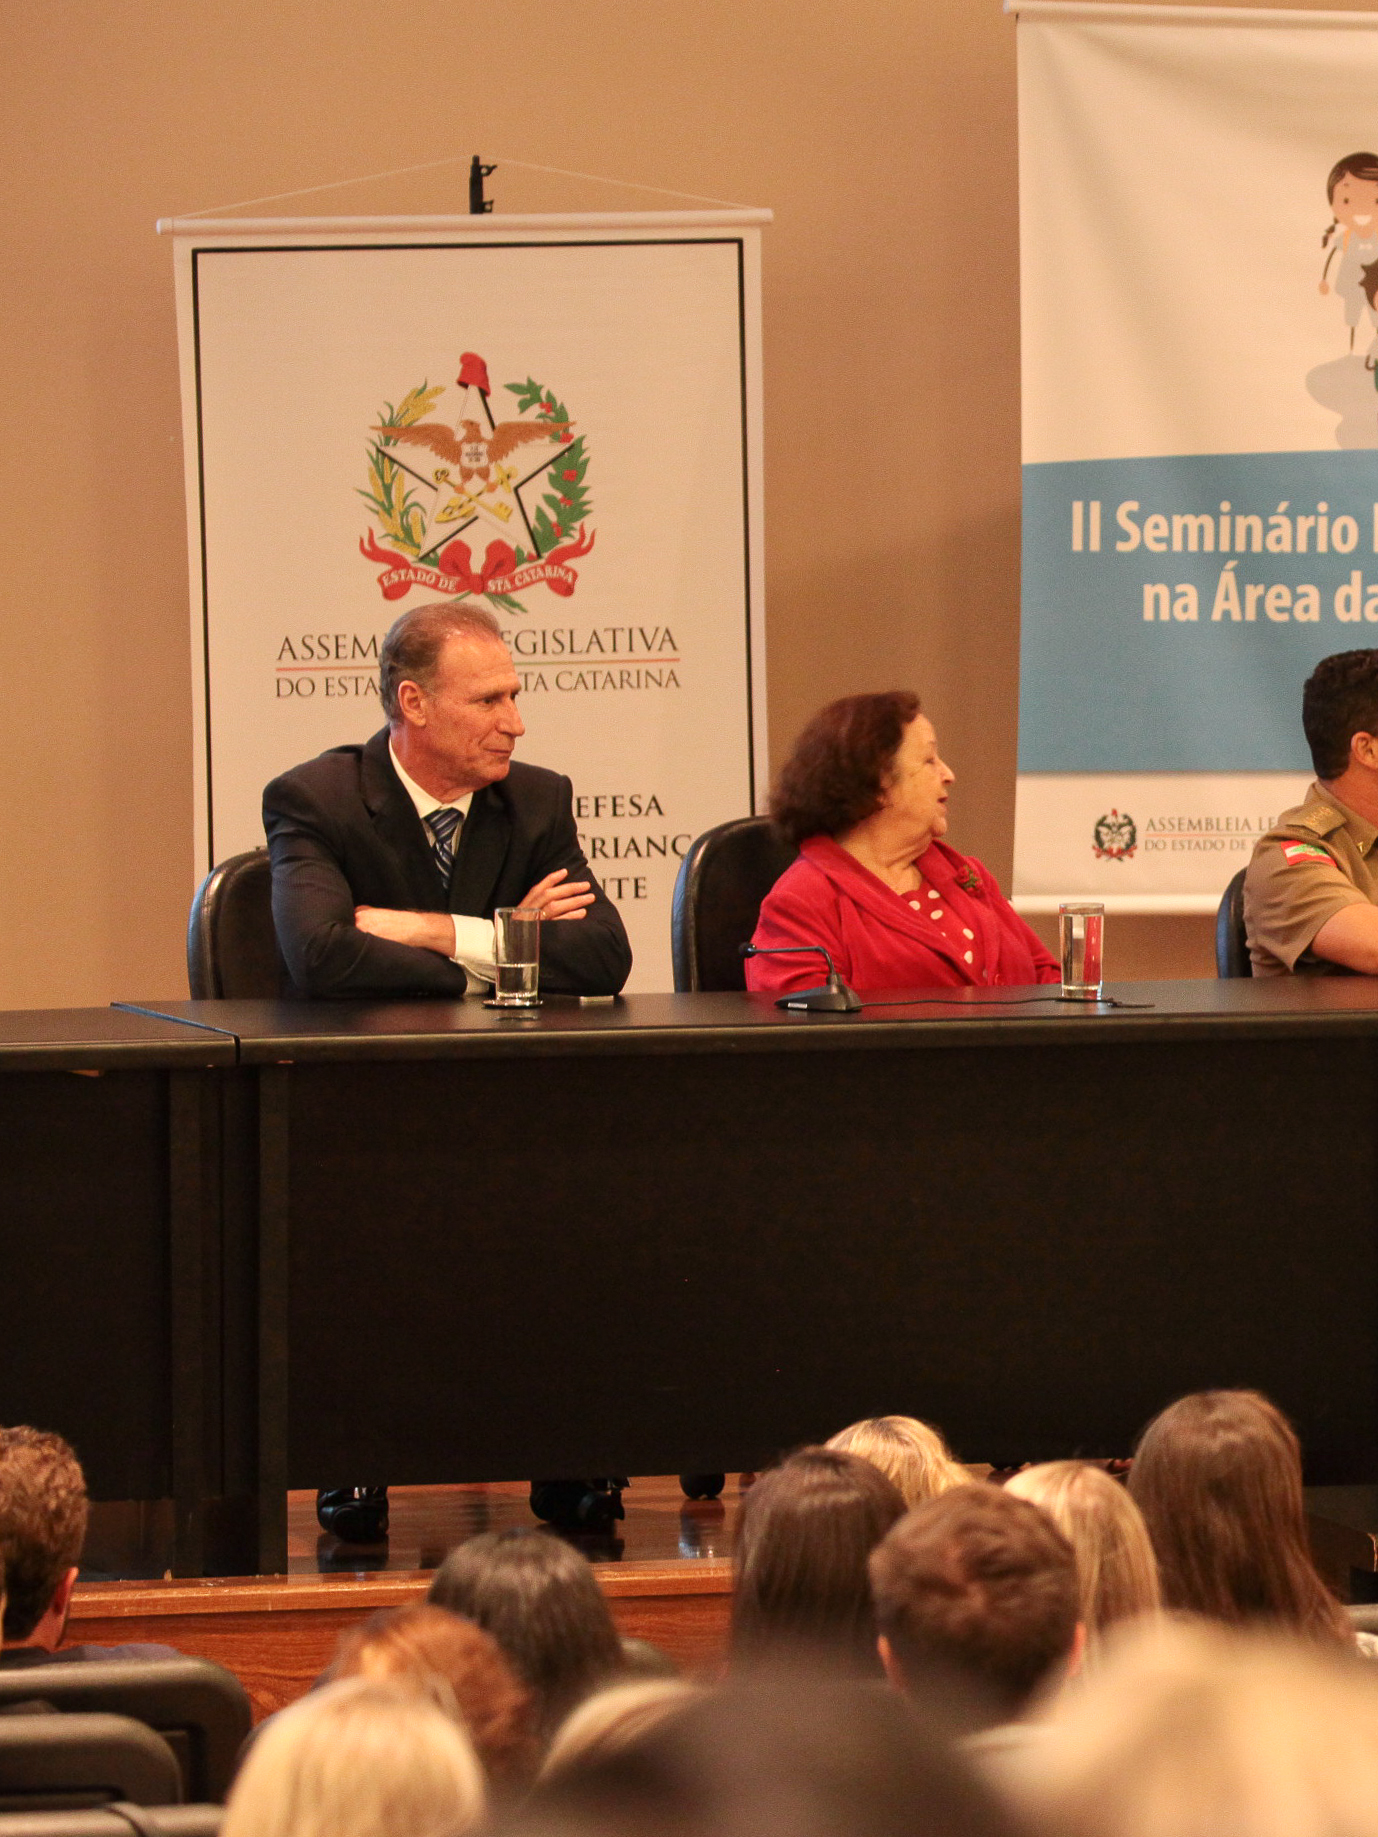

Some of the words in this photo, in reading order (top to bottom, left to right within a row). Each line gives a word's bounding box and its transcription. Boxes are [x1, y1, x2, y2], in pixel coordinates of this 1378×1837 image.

[1071, 501, 1100, 552] II
[1115, 500, 1359, 553] Seminário
[382, 567, 435, 587] ESTADO
[438, 577, 456, 591] DE
[488, 578, 512, 592] STA
[515, 564, 574, 586] CATARINA
[1143, 582, 1199, 622] na
[1211, 561, 1321, 622] Área
[276, 634, 379, 661] ASSEM
[501, 626, 679, 656] EGISLATIVA
[276, 677, 315, 697] DO
[325, 675, 380, 697] ESTA
[555, 668, 681, 692] CATARINA
[576, 794, 664, 818] EFESA
[1146, 816, 1252, 832] ASSEMBLEIA
[1145, 839, 1166, 851] DO
[1172, 838, 1225, 851] ESTADO
[1230, 838, 1247, 851] DE
